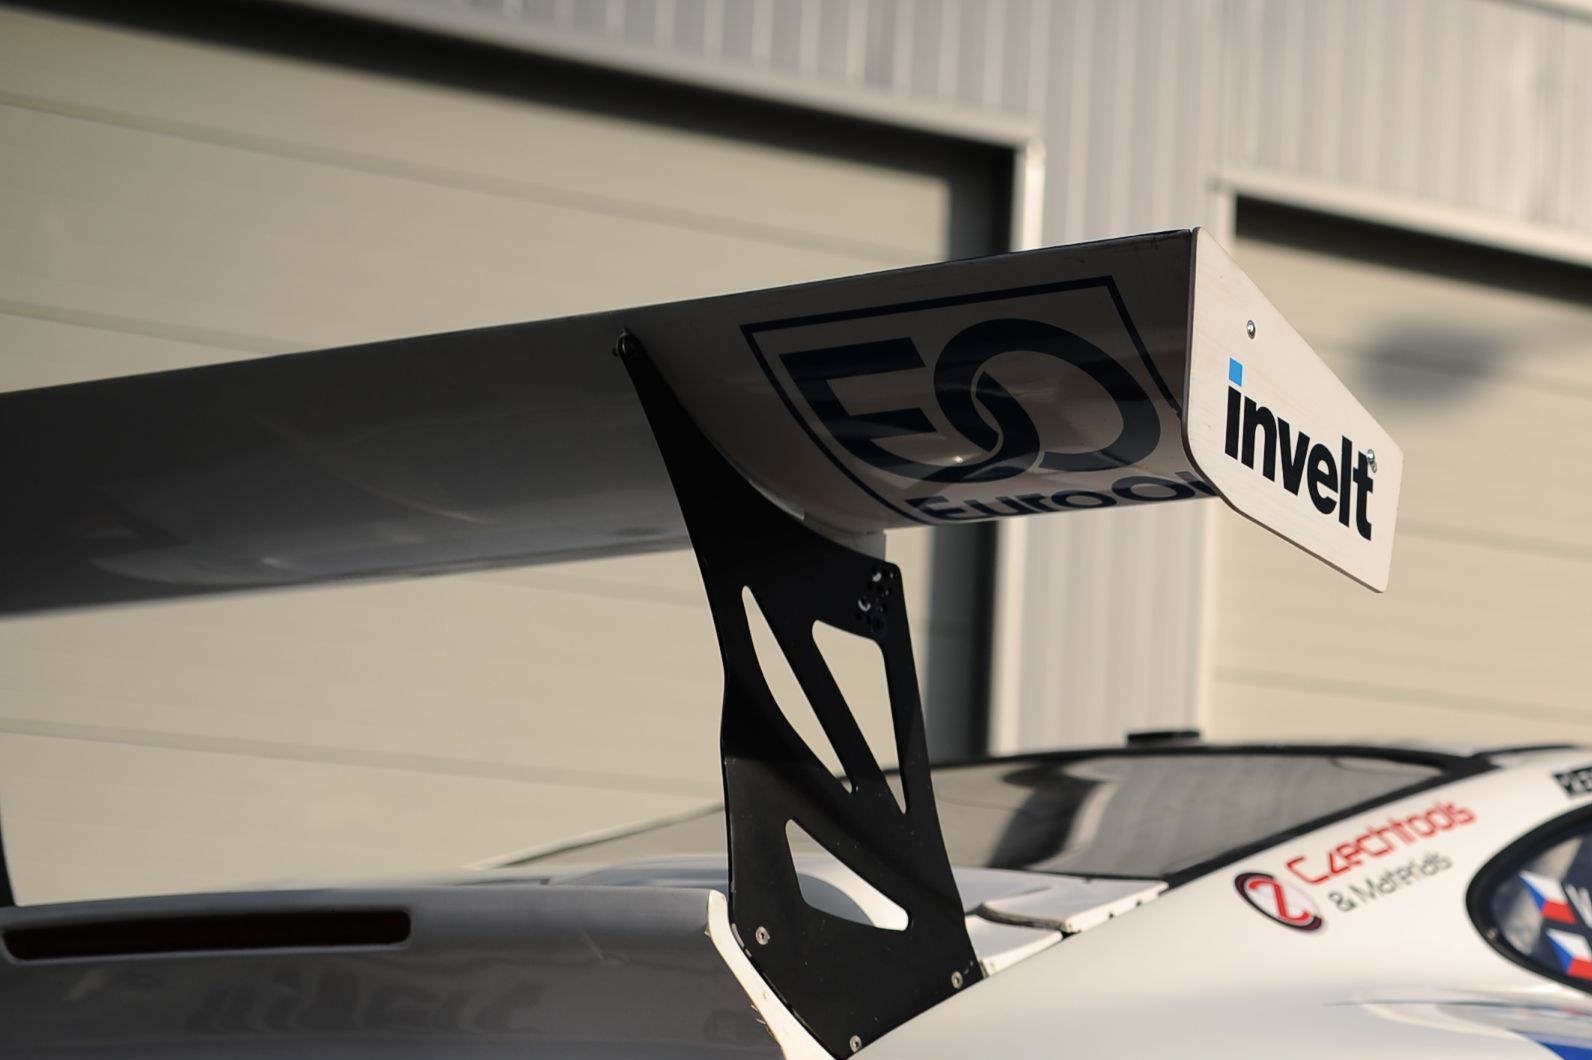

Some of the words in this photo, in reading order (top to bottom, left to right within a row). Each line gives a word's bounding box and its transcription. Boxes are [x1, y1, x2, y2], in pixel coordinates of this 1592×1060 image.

[1225, 357, 1374, 541] invelt
[905, 471, 1218, 520] EuroOi
[1285, 802, 1479, 886] Czechtools
[1351, 851, 1453, 904] Materials
